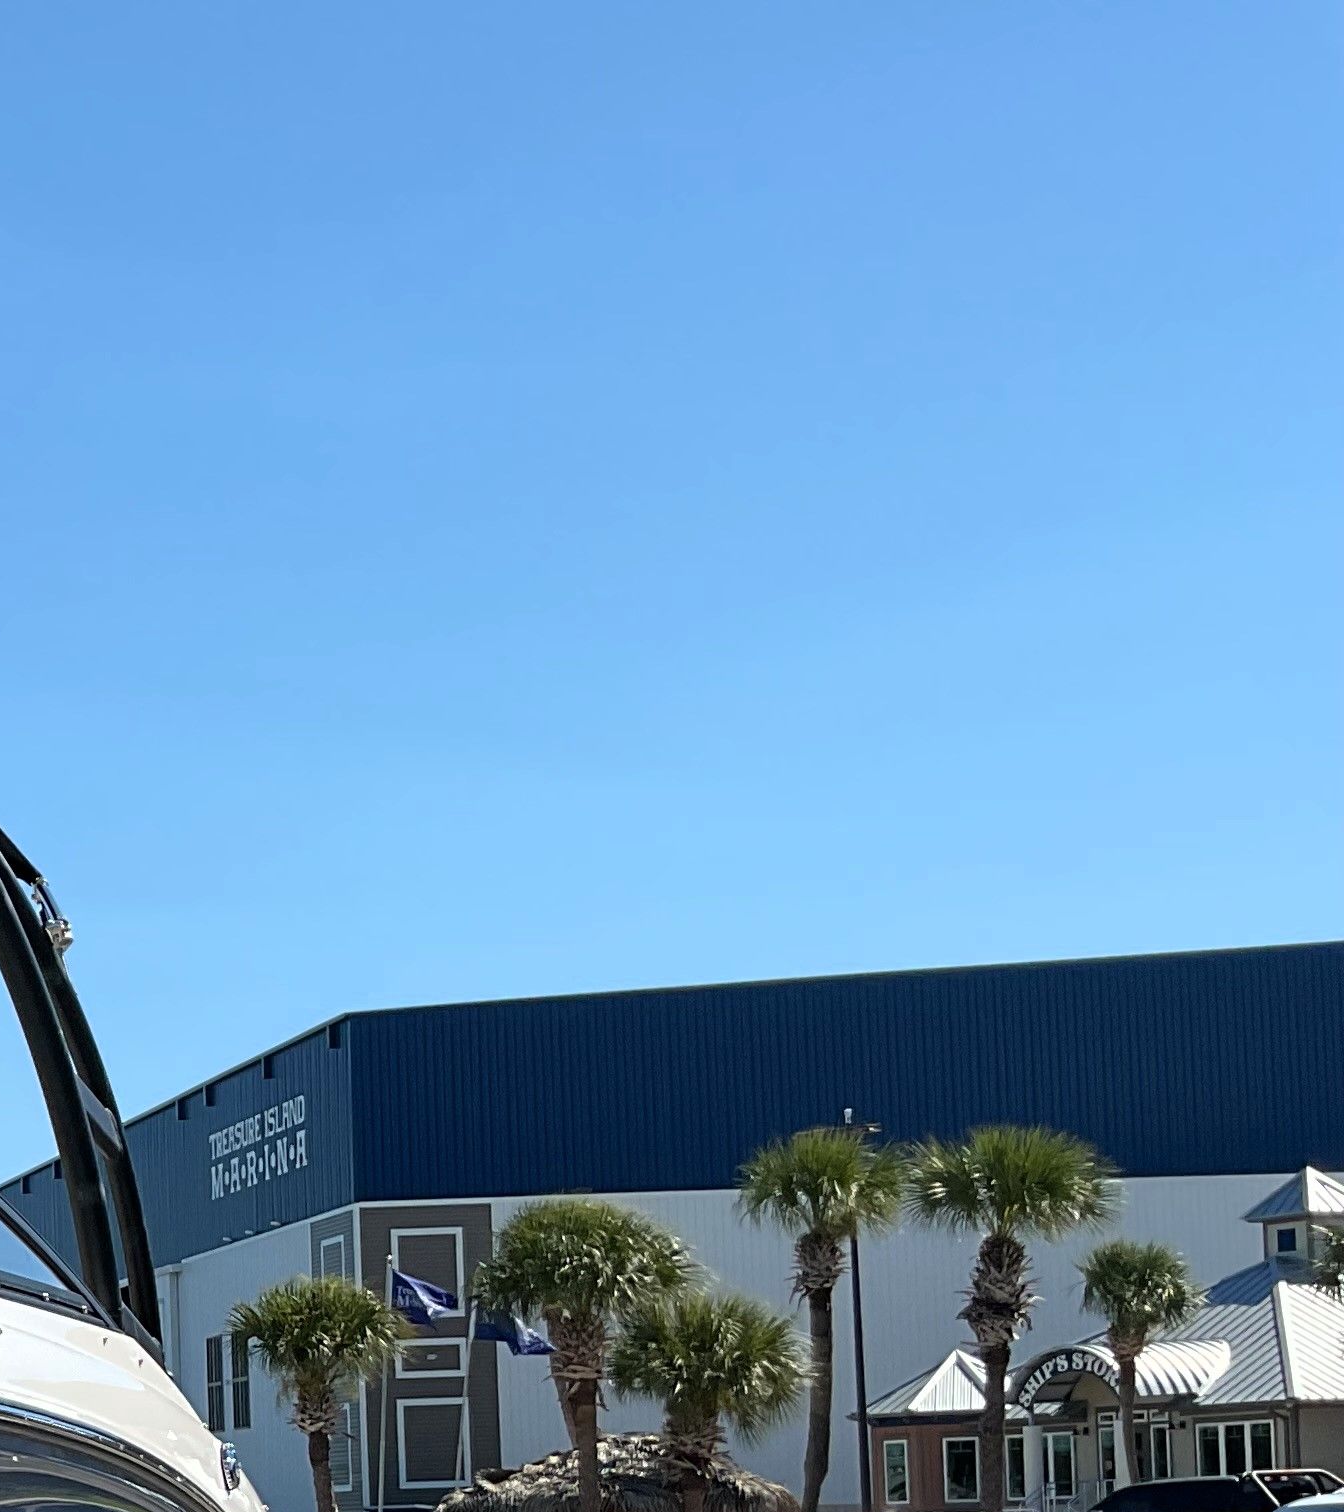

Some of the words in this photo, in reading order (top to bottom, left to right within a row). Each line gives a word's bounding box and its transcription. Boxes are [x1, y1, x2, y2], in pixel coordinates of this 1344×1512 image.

[209, 1113, 262, 1160] TREASURE
[264, 1095, 305, 1138] ISLAND
[1018, 1354, 1069, 1407] SHIP'S
[1072, 1352, 1121, 1395] STOR
